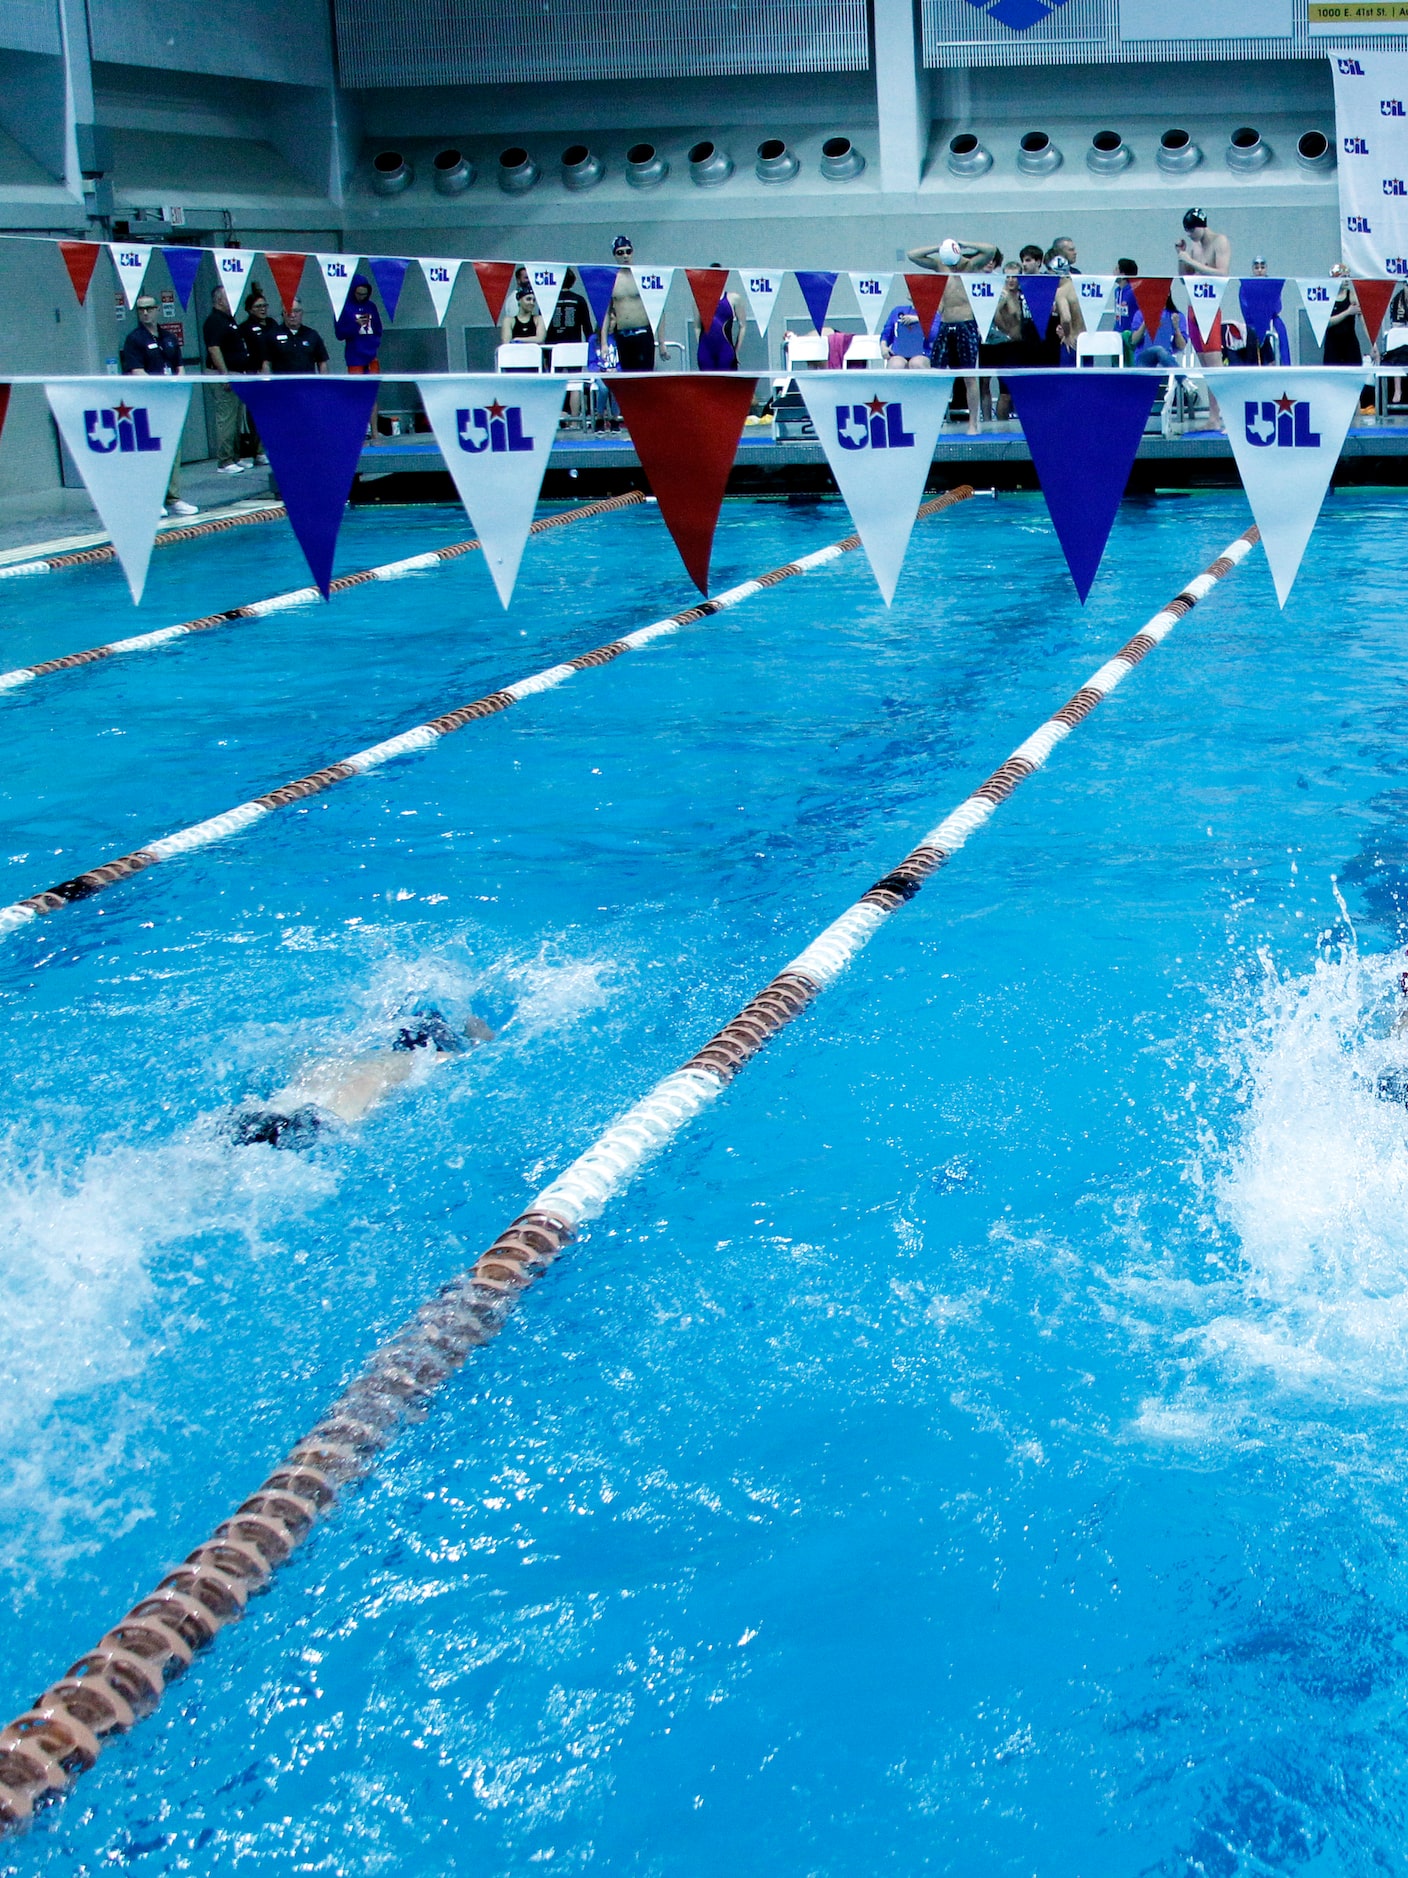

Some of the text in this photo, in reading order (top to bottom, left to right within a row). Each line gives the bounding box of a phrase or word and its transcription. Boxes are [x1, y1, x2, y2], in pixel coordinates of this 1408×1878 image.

[1317, 8, 1341, 18] 1000
[1344, 8, 1352, 17] E.
[1355, 8, 1374, 17] 41st
[1376, 8, 1388, 17] St.
[1337, 56, 1365, 76] UIL
[1380, 98, 1407, 117] UIL
[1343, 136, 1369, 155] UIL
[1382, 177, 1408, 196] UIL
[1347, 215, 1372, 234] UIL
[120, 252, 142, 267] UIL
[223, 257, 244, 273] UIL
[327, 262, 348, 278] UIL
[430, 266, 450, 282] UIL
[535, 270, 557, 286] UIL
[641, 274, 664, 290] UIL
[750, 277, 773, 293] UIL
[859, 279, 882, 295] UIL
[971, 281, 995, 297] UIL
[1081, 281, 1103, 298] UIL
[1193, 282, 1217, 299] UIL
[1307, 285, 1330, 302] UIL
[84, 398, 163, 454] UIL
[455, 397, 535, 454] UIL
[835, 393, 916, 451] UIL
[1244, 391, 1322, 448] UIL
